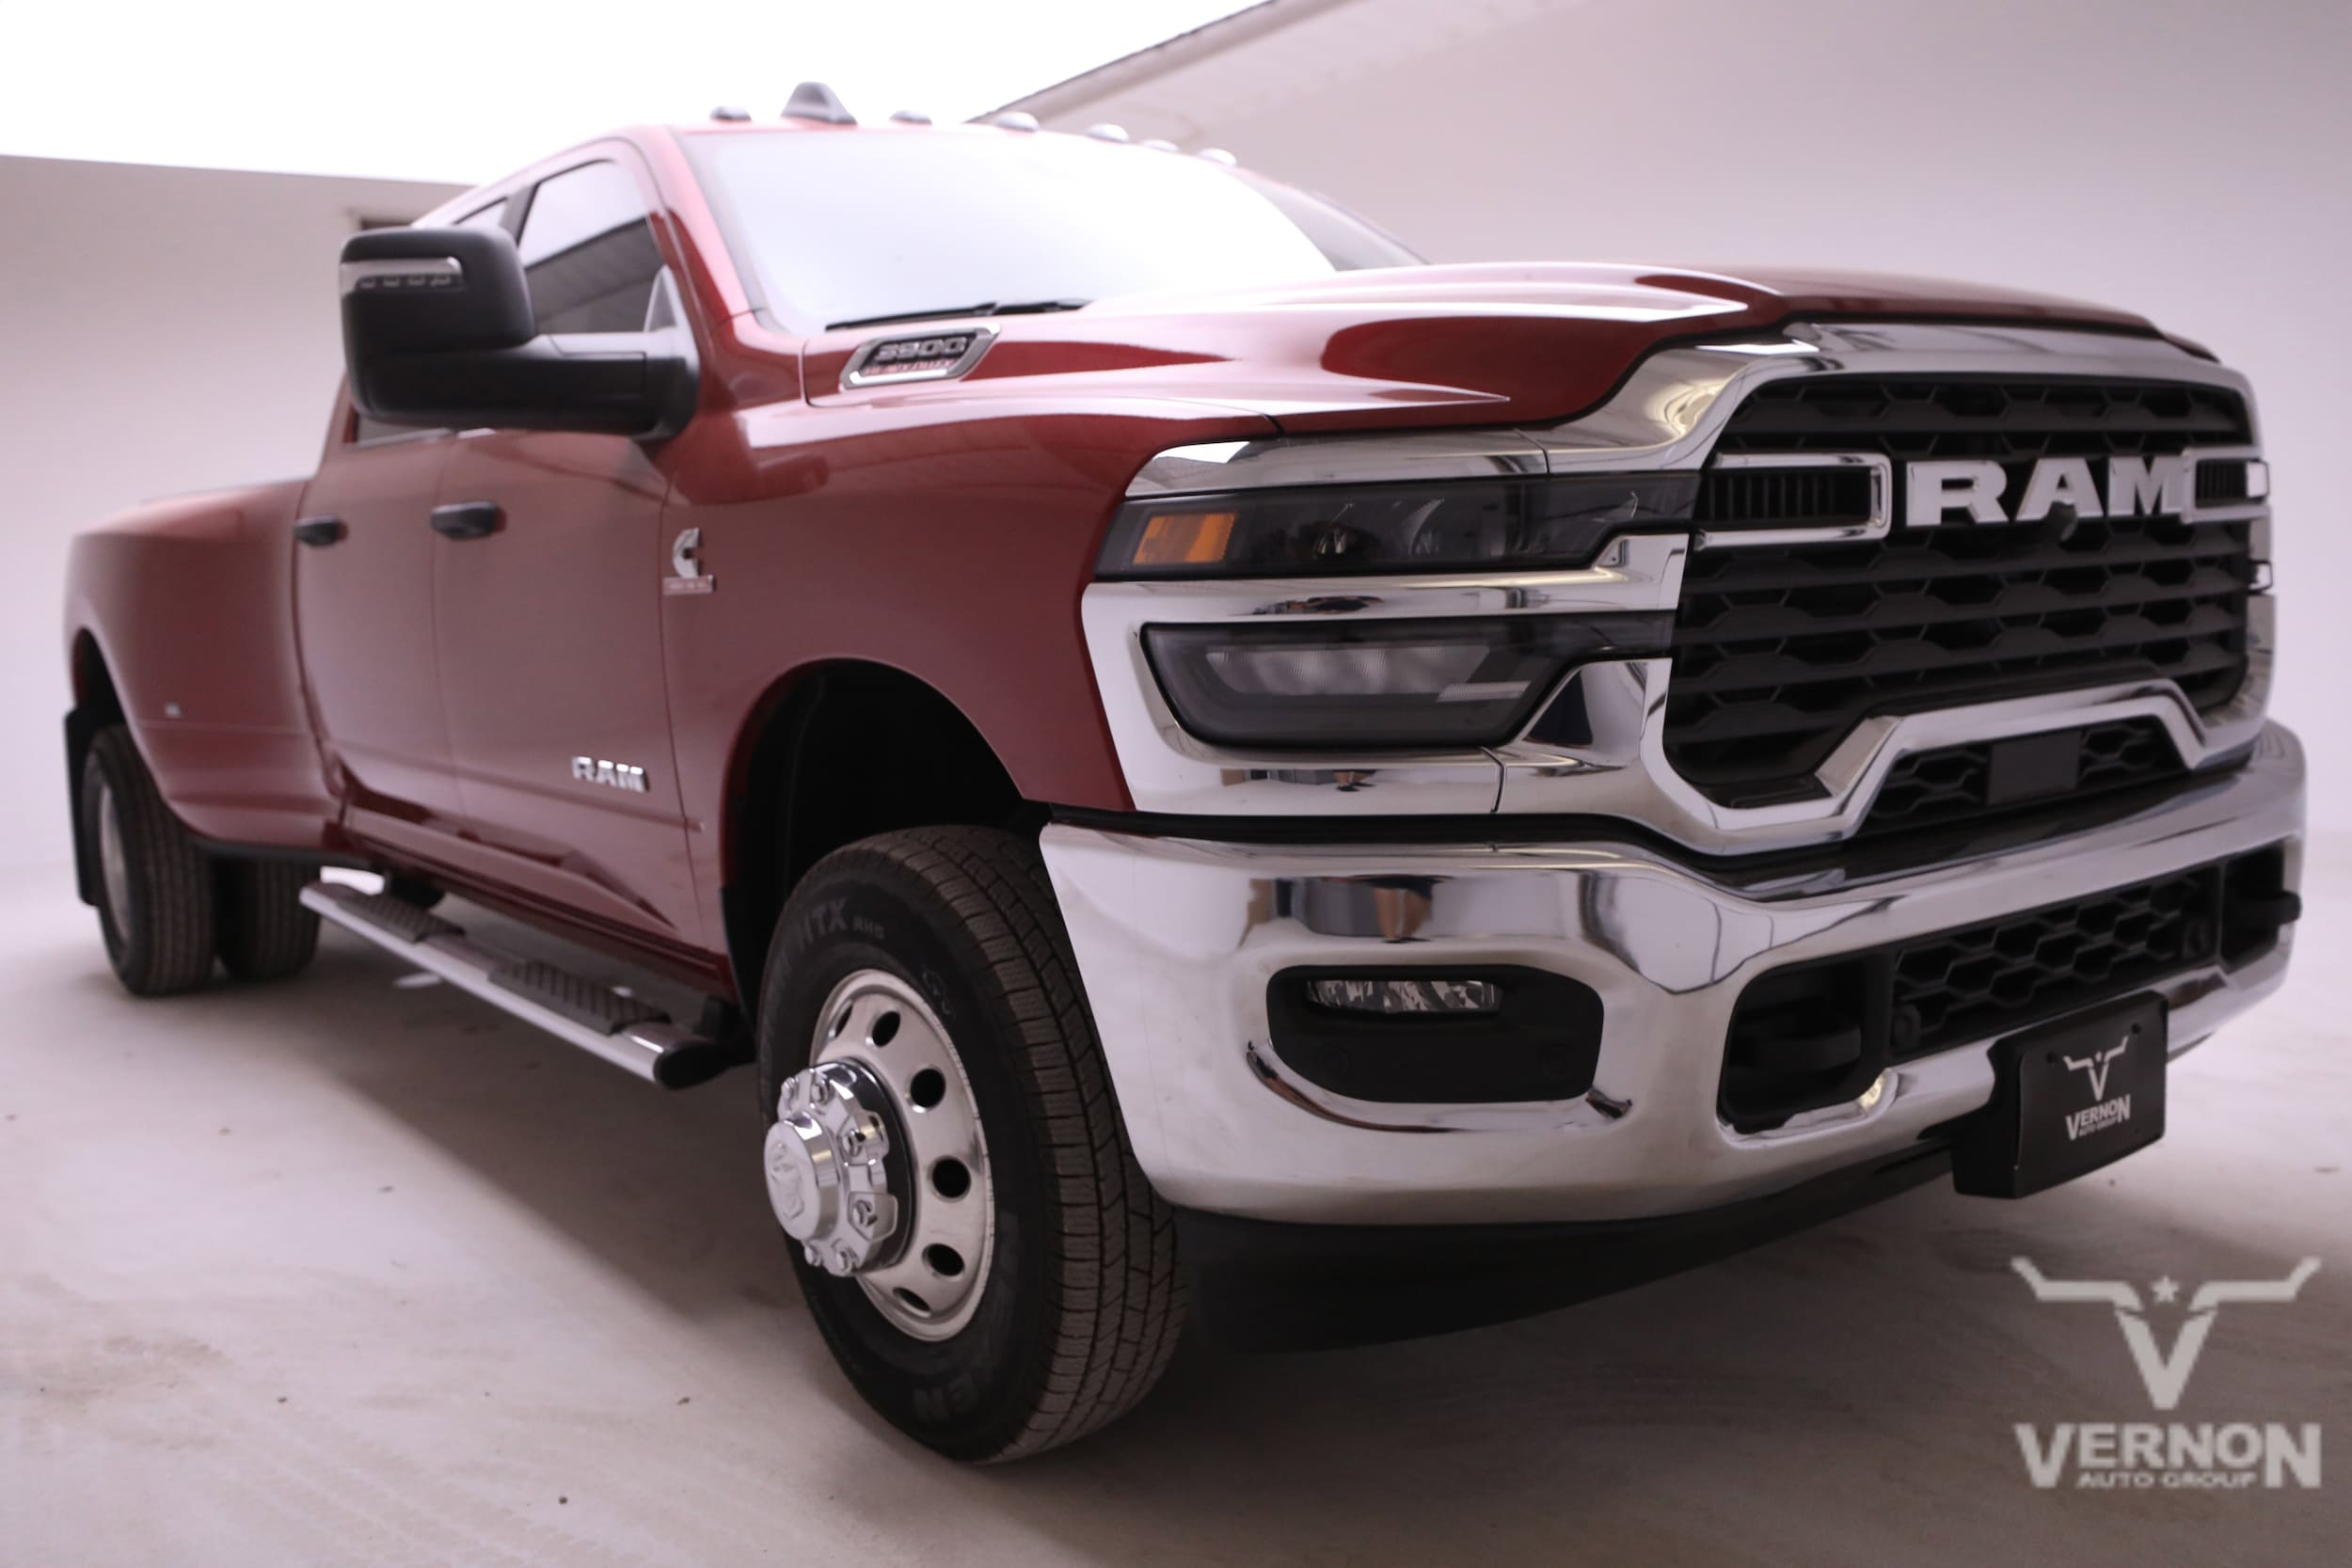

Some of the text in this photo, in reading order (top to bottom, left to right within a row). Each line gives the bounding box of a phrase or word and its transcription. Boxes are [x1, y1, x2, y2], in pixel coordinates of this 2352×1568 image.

[1906, 455, 2185, 527] RAM
[571, 755, 645, 793] RAM
[2065, 1093, 2131, 1141] VERNON
